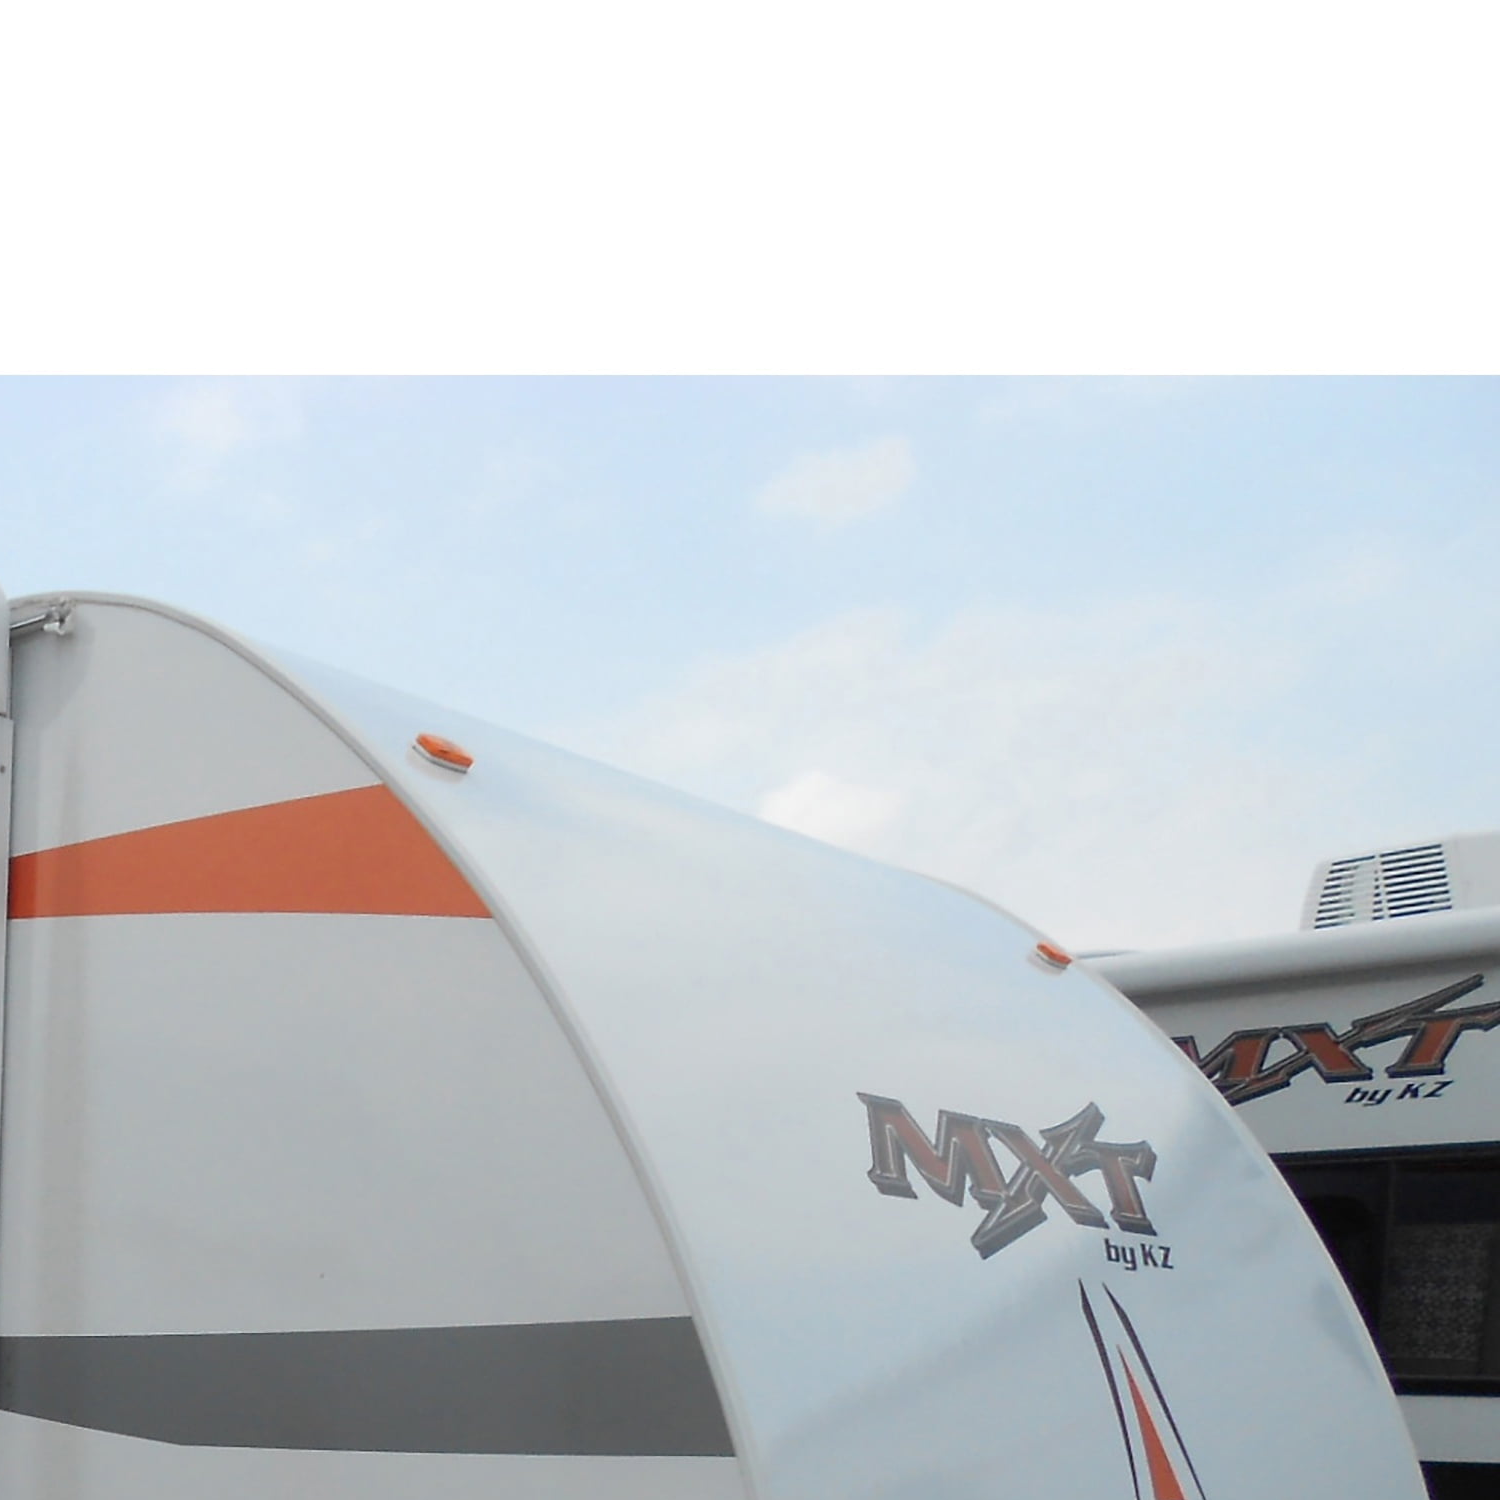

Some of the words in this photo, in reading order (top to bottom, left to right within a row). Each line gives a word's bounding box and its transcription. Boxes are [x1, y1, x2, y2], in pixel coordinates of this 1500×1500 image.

[1344, 1086, 1392, 1107] by
[1396, 1080, 1454, 1100] KZ
[856, 1091, 1158, 1260] MXT
[1104, 1238, 1137, 1271] by
[1140, 1242, 1175, 1270] KZ
